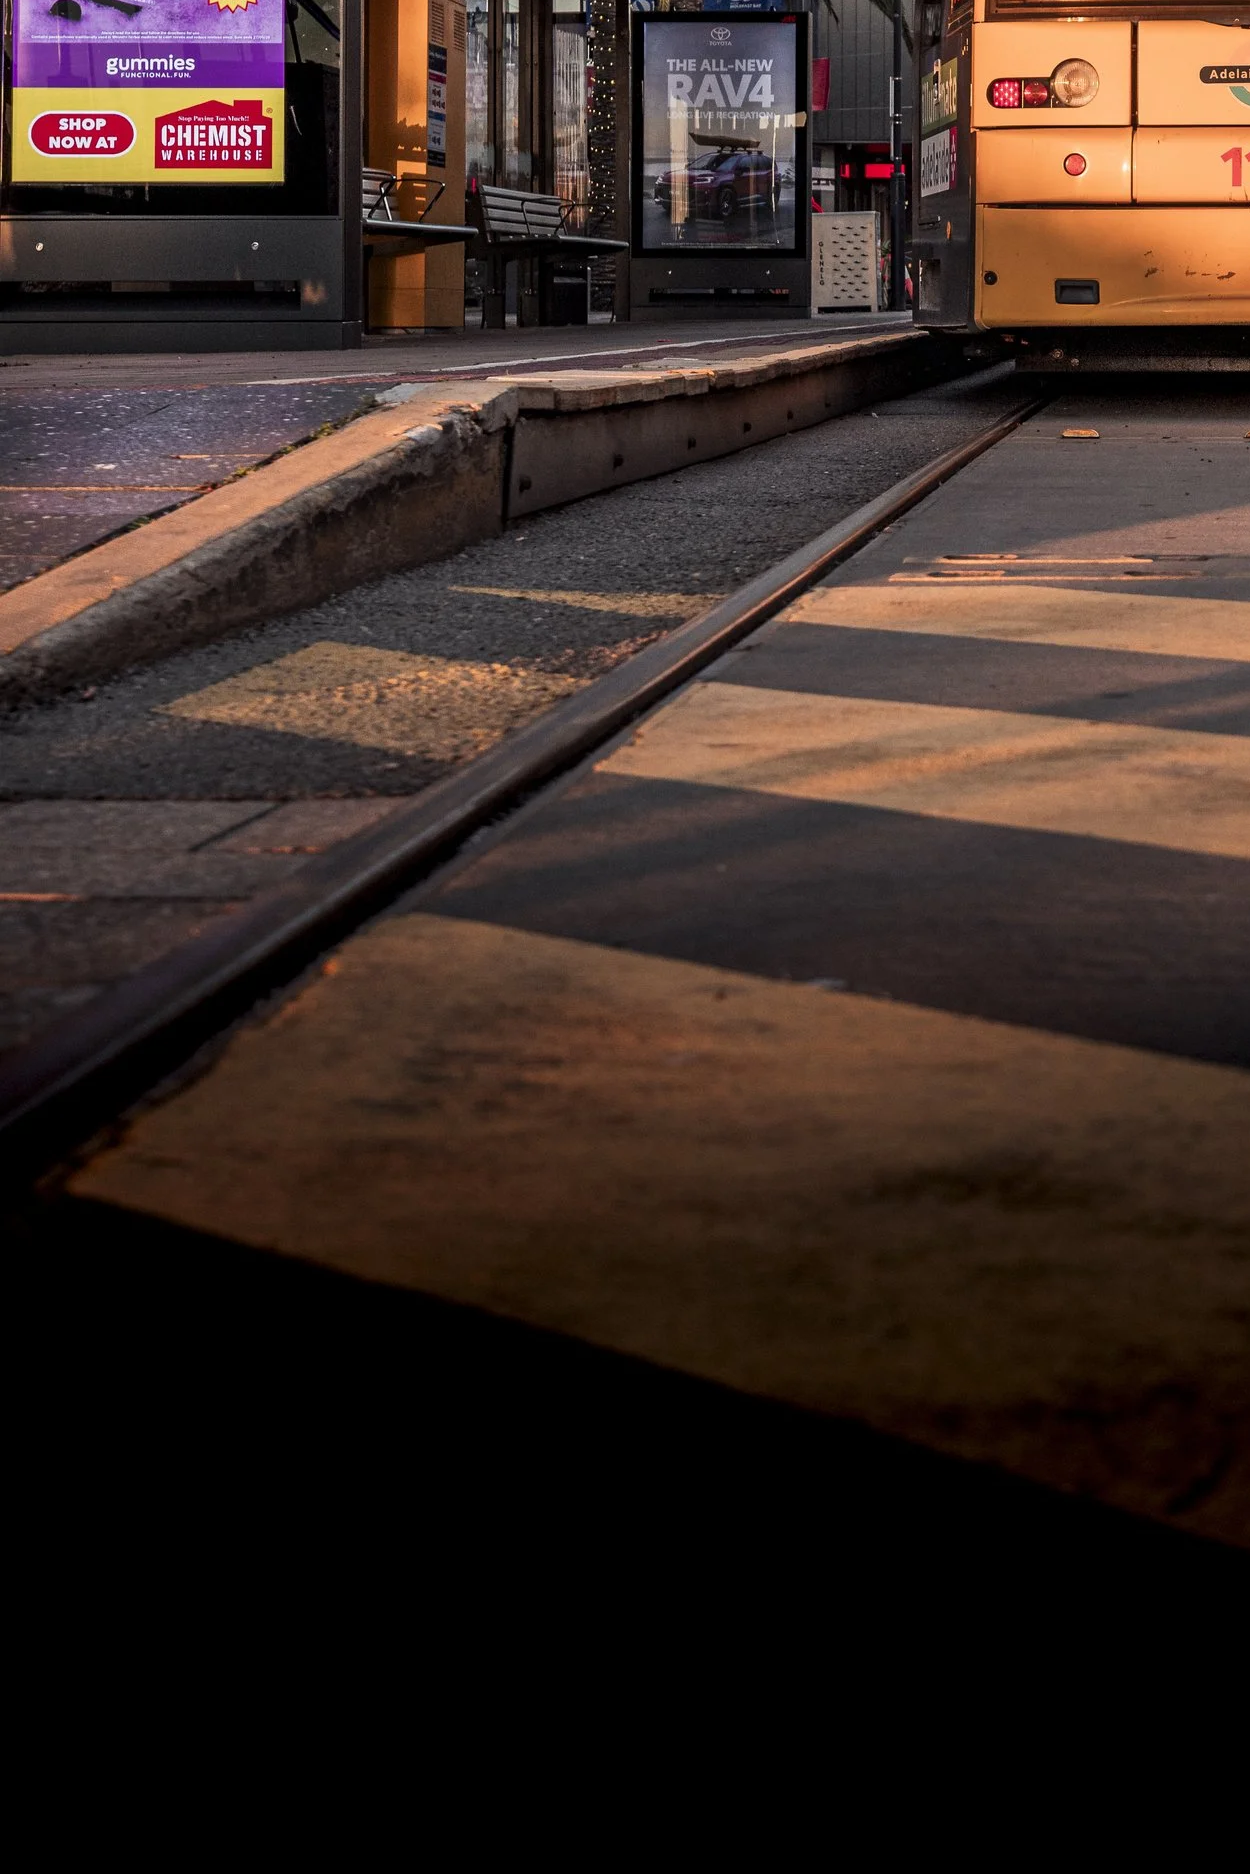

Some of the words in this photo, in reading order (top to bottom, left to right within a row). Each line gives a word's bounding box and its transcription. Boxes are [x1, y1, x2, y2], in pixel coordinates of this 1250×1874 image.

[106, 54, 196, 75] gummies
[667, 59, 697, 72] THE
[700, 59, 774, 72] ALL-NEW
[667, 74, 775, 108] RAV4
[667, 111, 692, 120] LONG
[694, 111, 714, 120] LIVE
[59, 118, 107, 131] SHOP
[161, 124, 267, 147] CHEMIST
[49, 136, 91, 149] NOW
[95, 136, 118, 149] AT
[161, 149, 263, 161] WAREHOUSE
